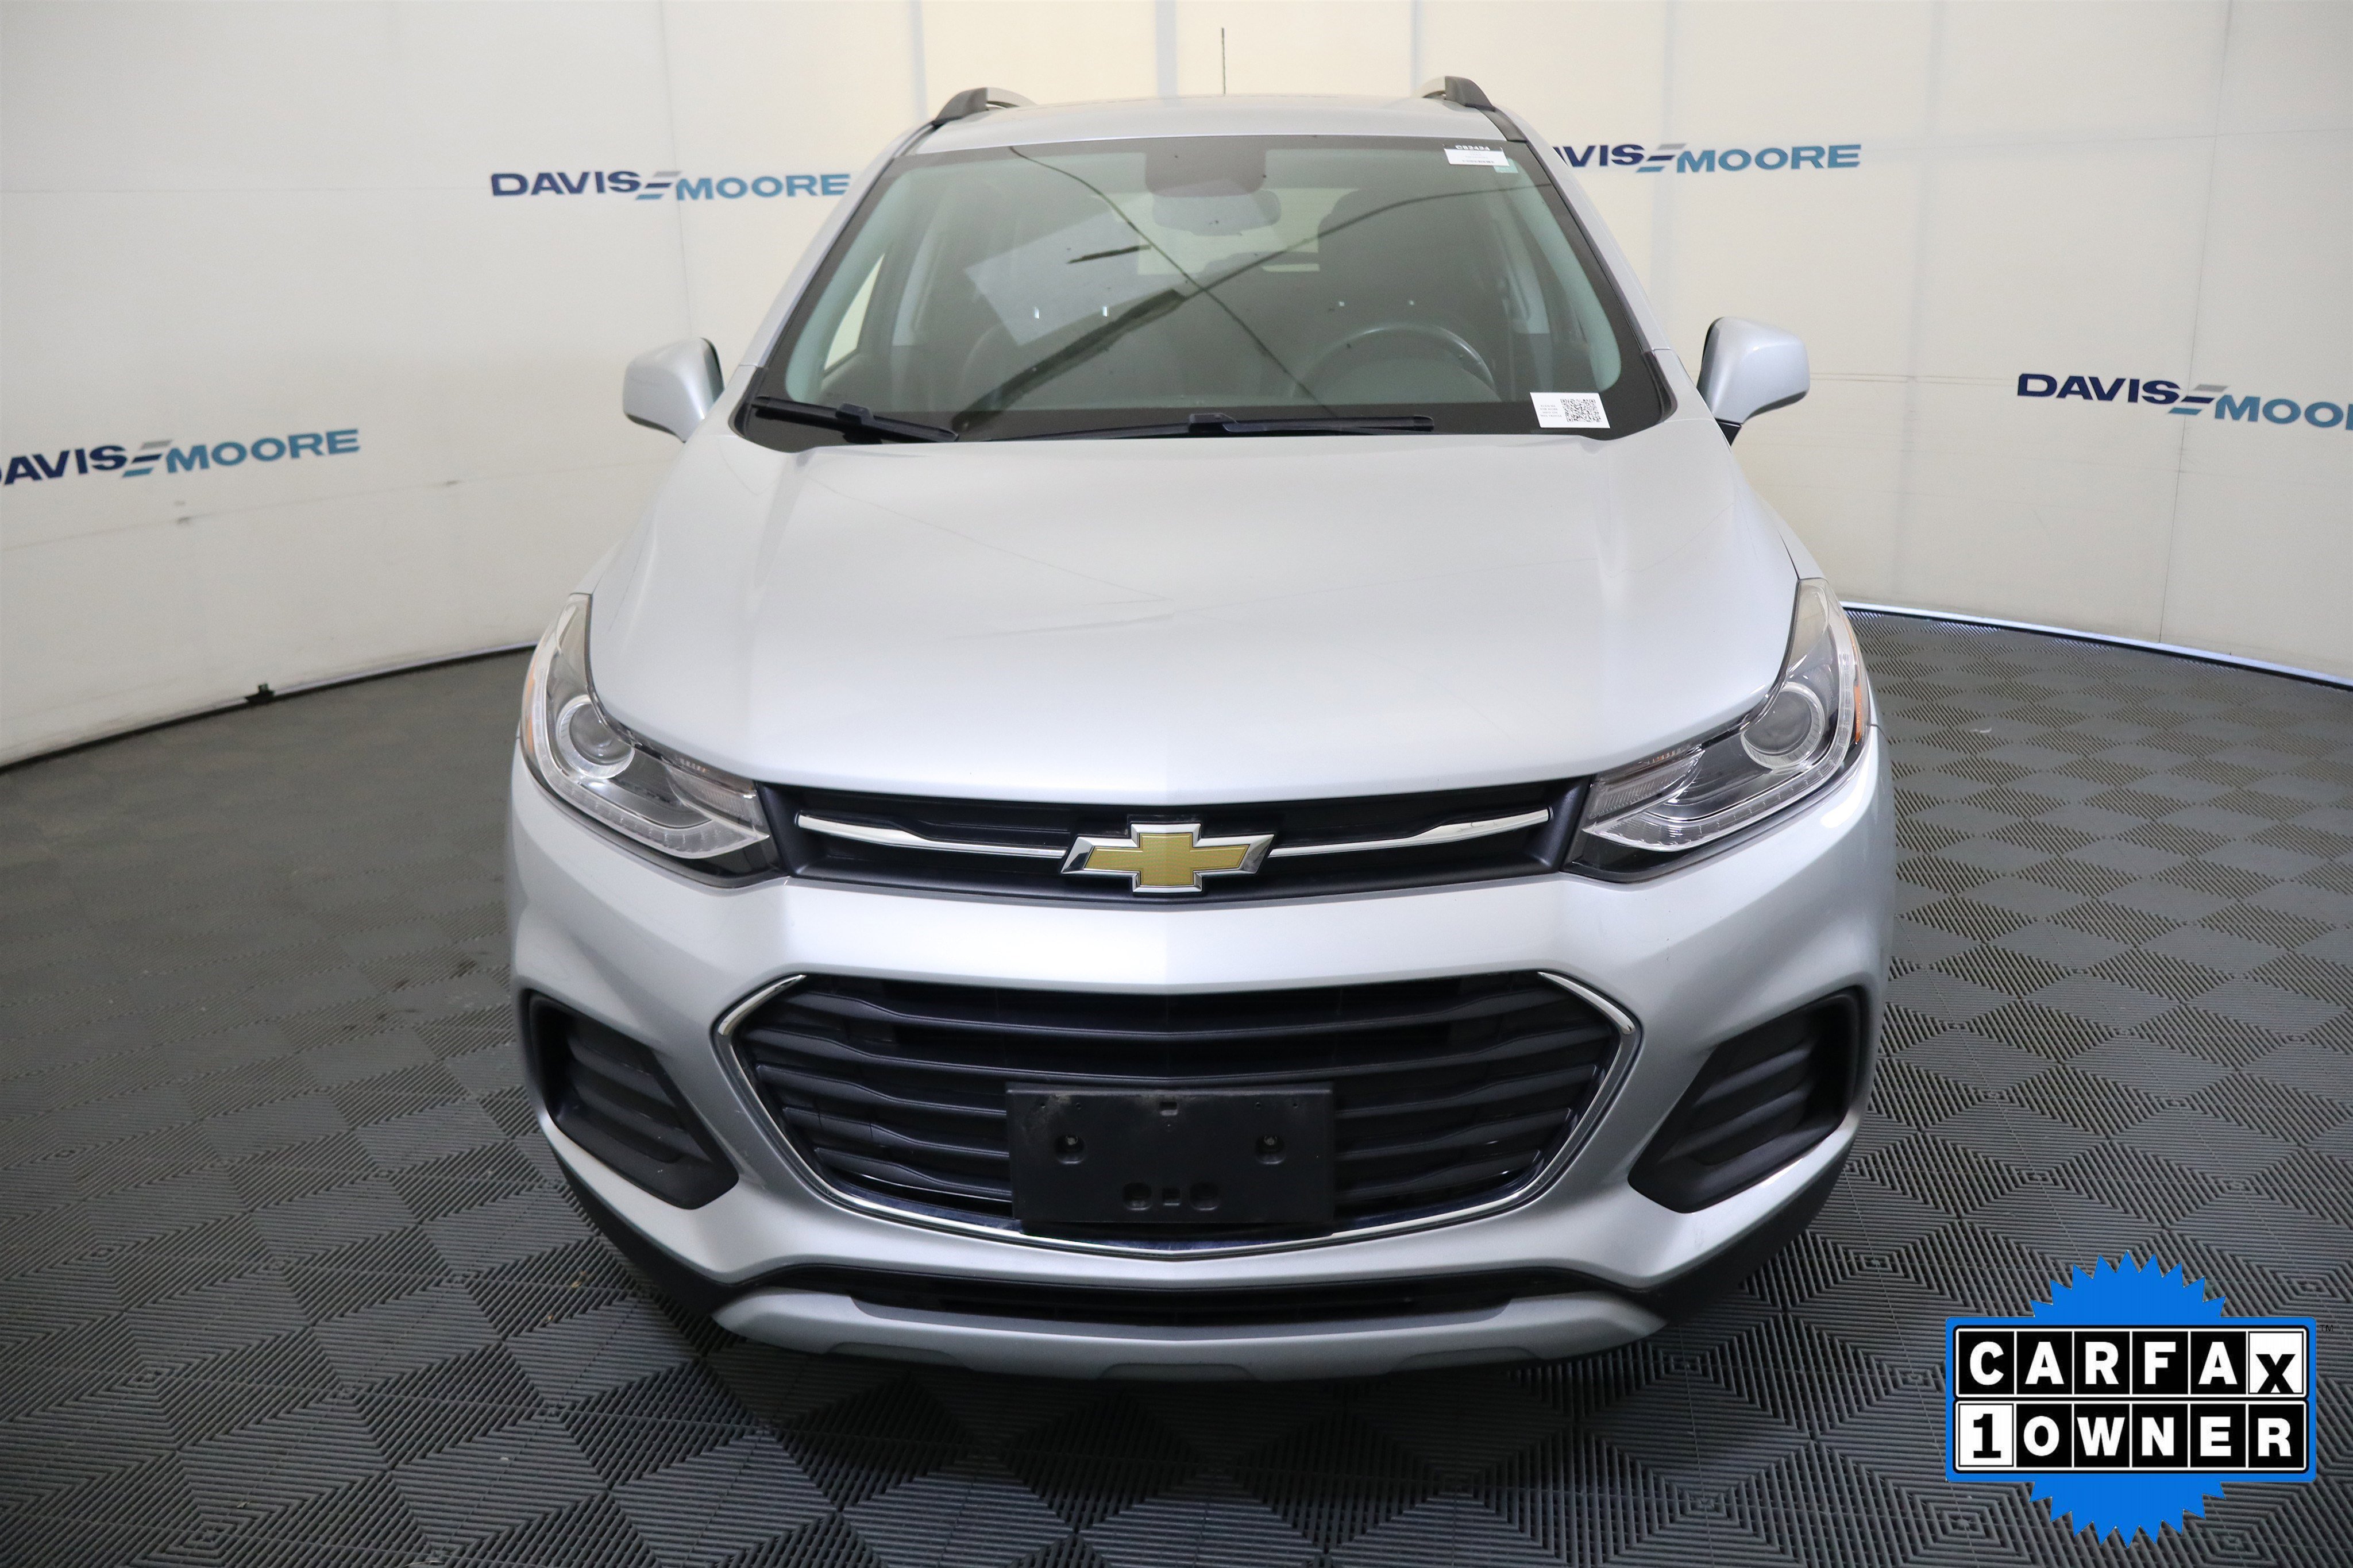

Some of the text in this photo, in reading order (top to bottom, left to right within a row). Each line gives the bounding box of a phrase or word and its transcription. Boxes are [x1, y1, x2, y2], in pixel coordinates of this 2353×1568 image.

[1552, 144, 1862, 173] VIS MOORE
[491, 171, 850, 200] DAVIS MOORE
[2018, 373, 2353, 430] DAVIS MOO
[0, 429, 360, 485] AVIS MOORE
